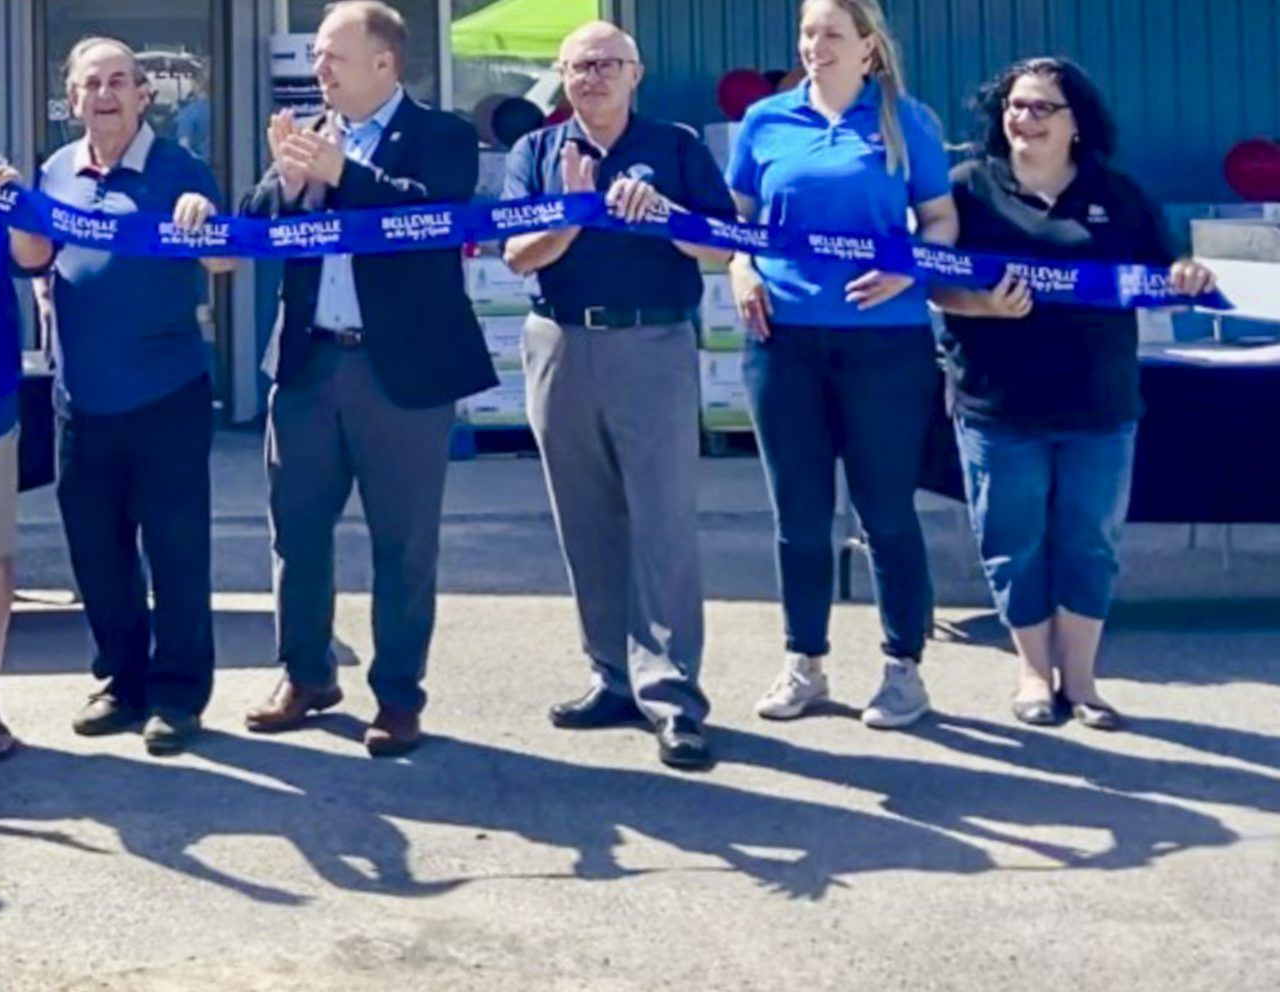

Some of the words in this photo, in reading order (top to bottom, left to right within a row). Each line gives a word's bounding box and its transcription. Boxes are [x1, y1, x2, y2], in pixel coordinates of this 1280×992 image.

[269, 219, 342, 239] BELLEVILLE
[381, 211, 452, 230] BELLEVILLE
[808, 234, 876, 251] BELLEVILLE
